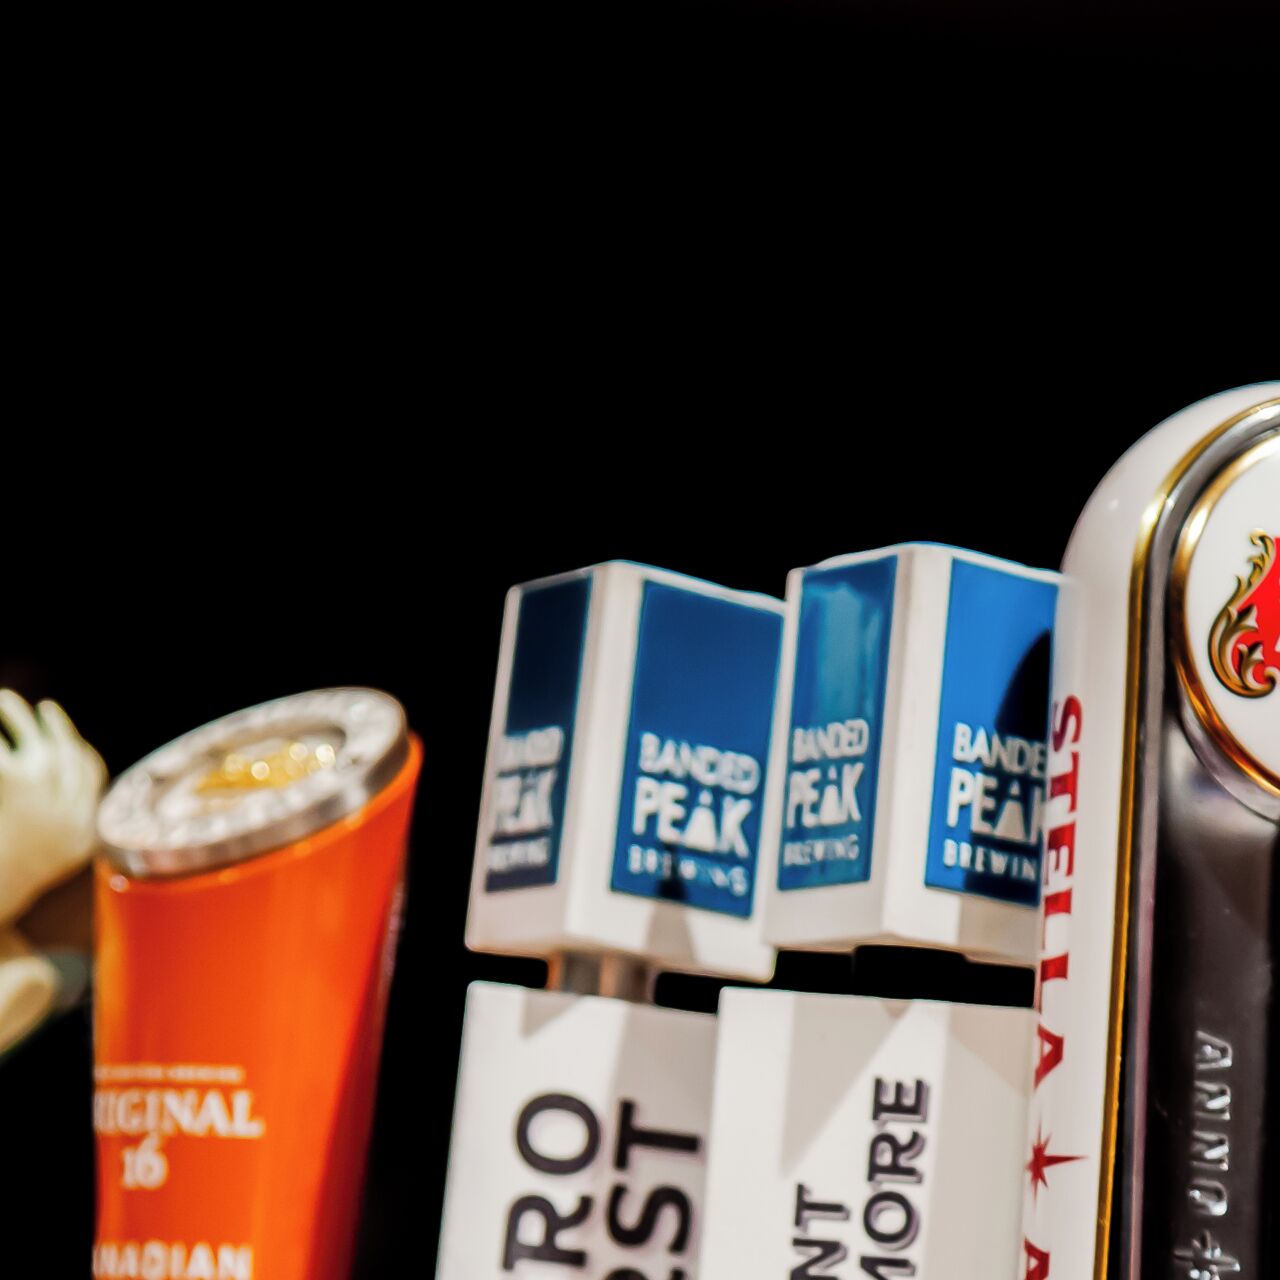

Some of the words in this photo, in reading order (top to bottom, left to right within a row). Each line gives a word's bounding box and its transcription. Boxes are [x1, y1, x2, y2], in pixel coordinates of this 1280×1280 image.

[638, 731, 761, 795] BANDED
[792, 718, 870, 764] BANDED
[632, 775, 753, 859] PEAK
[786, 761, 865, 829] PEAK
[783, 833, 860, 867] BREWING
[1035, 694, 1083, 1092] STELLA
[1190, 1030, 1234, 1217] ANNO
[122, 1130, 168, 1190] 16
